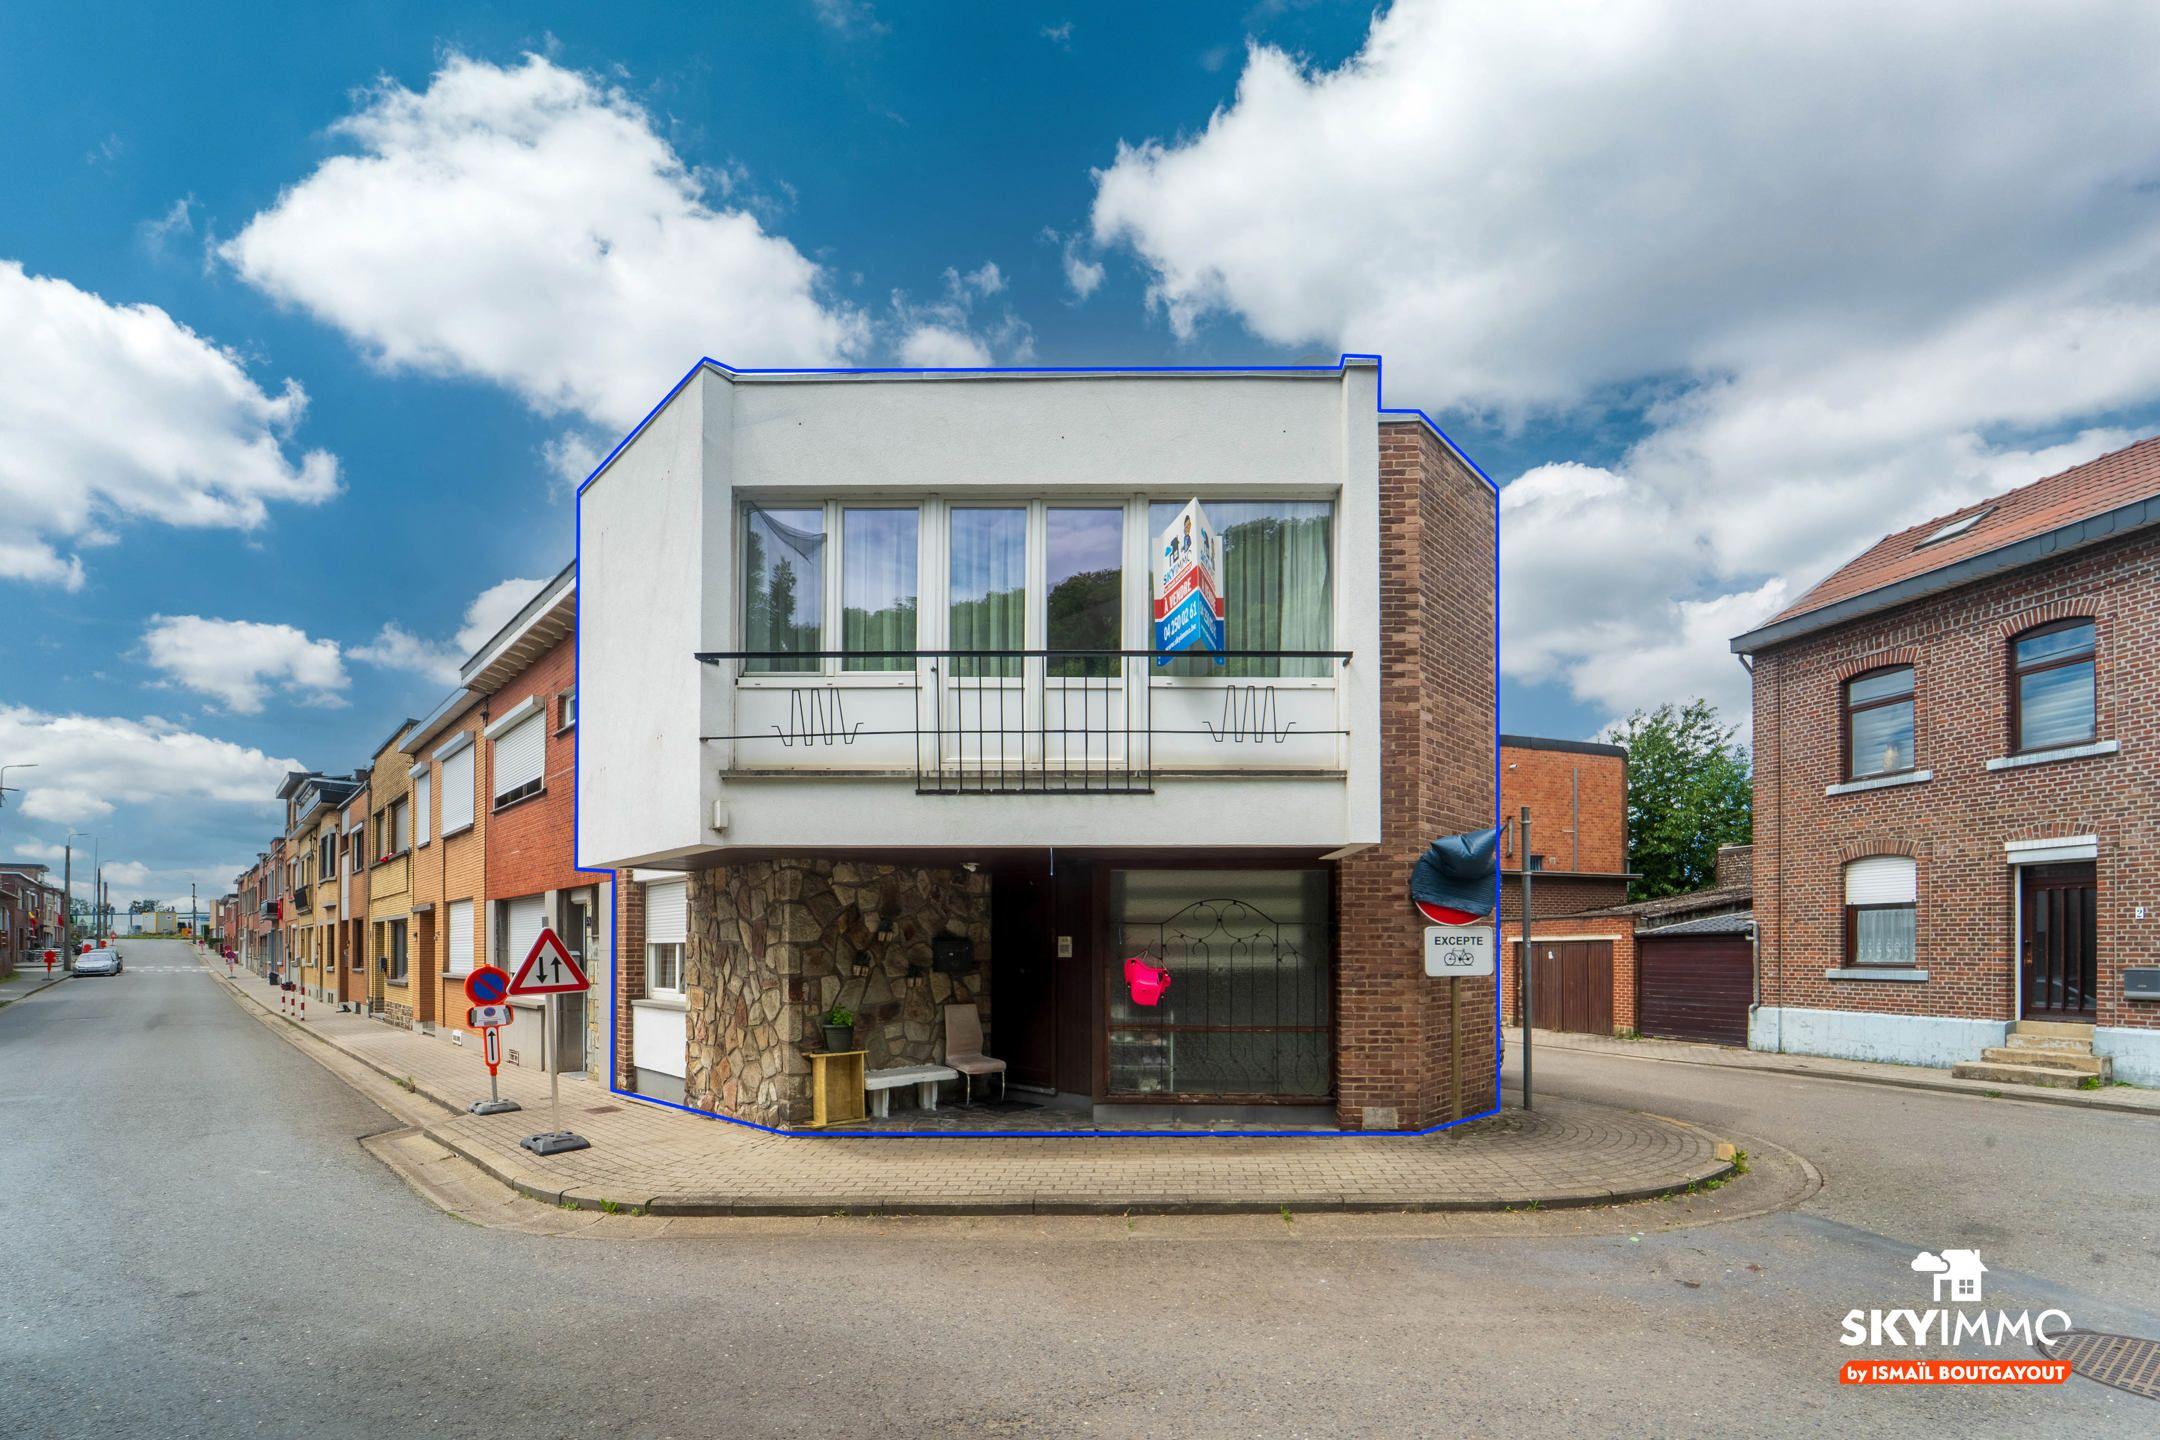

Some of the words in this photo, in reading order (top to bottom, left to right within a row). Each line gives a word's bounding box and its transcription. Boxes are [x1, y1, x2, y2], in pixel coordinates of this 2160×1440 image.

[1169, 576, 1192, 609] VENDRE
[1189, 600, 1197, 619] 61
[1434, 936, 1484, 946] EXCEPTE
